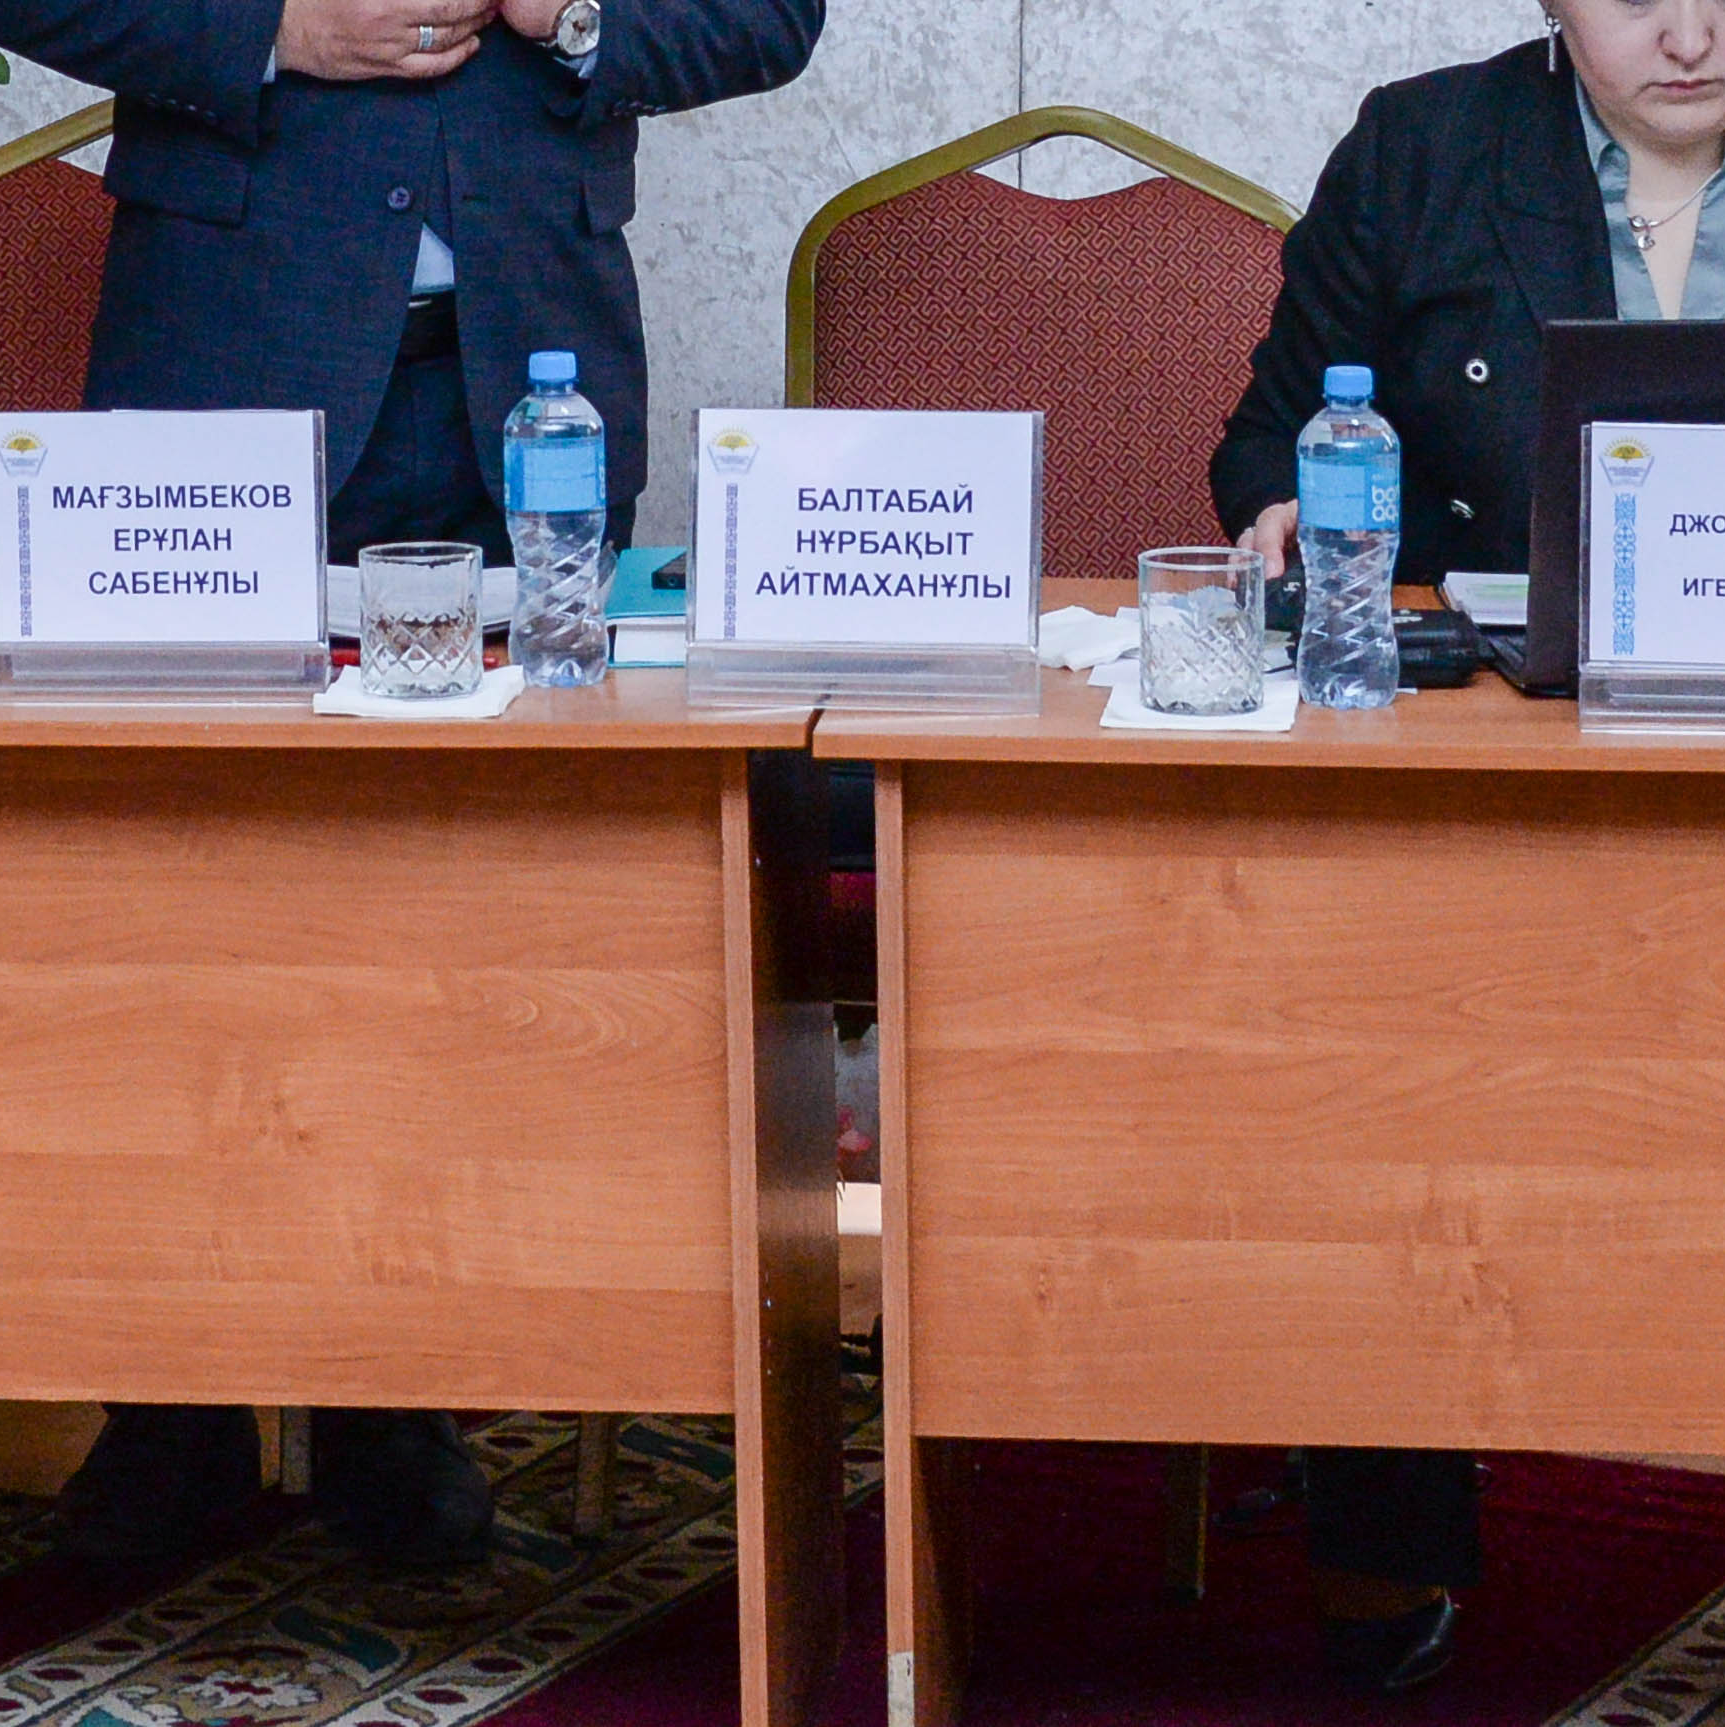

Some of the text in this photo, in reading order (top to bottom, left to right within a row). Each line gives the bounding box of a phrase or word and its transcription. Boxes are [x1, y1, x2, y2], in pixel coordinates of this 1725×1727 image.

[52, 484, 292, 509] МАҒЗЫМБЕКОВ
[798, 483, 973, 514] БАЛТАБАЙ
[113, 527, 232, 552] ЕРҰЛАН
[796, 529, 974, 561] НҰРБАҚЫТ
[88, 570, 259, 595] САБЕНҰЛЫ
[755, 566, 1011, 599] АЙТМАХАНҰЛЫ
